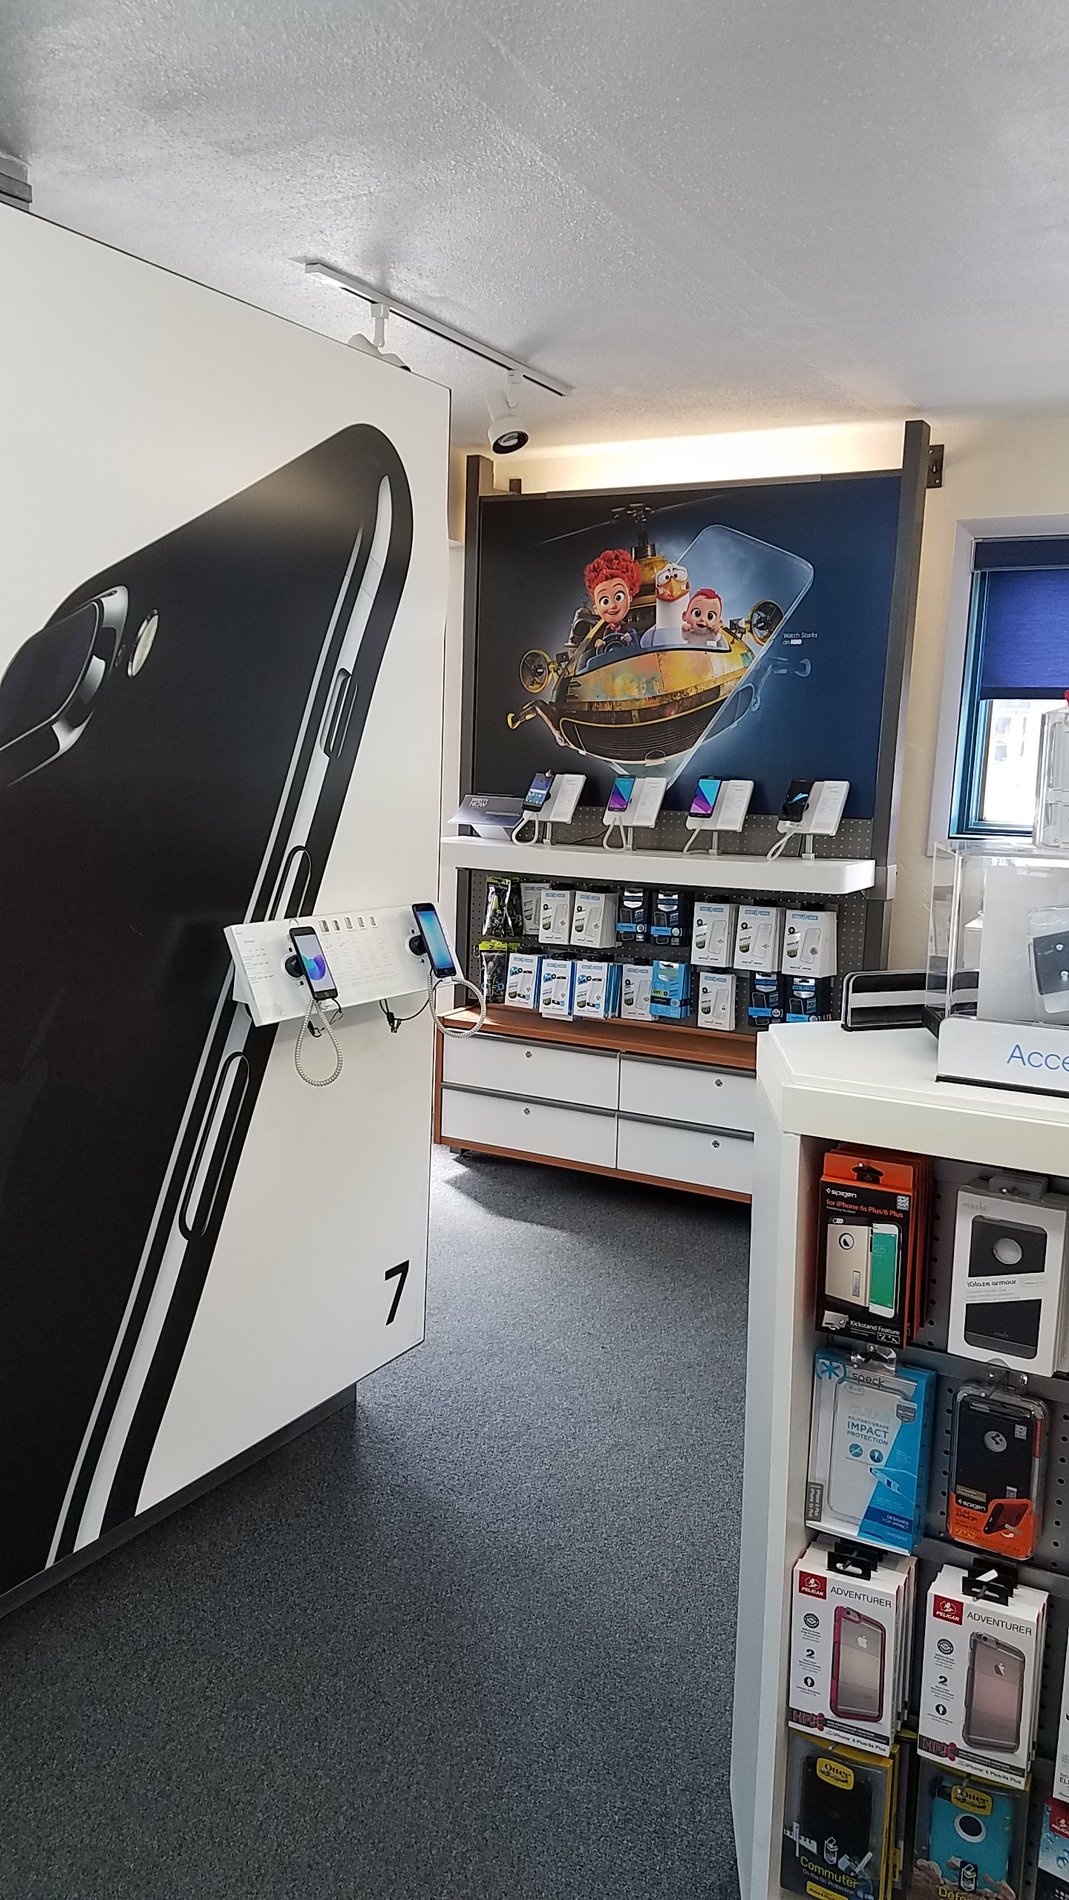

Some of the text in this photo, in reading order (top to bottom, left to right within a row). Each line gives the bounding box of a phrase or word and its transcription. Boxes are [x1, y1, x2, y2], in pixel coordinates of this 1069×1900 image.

[831, 1189, 857, 1199] spigen
[836, 1200, 859, 1211] iPhone
[889, 1210, 904, 1218] Plus
[991, 1279, 1017, 1287] armour
[384, 1259, 409, 1326] 7
[850, 1320, 878, 1331] Kickstand
[878, 1326, 900, 1335] Feature
[852, 1372, 885, 1388] speck
[847, 1420, 889, 1439] IMPACT
[847, 1430, 888, 1446] PROTECTION
[801, 1586, 824, 1596] PELICAN
[830, 1586, 892, 1608] ADVENTURER
[935, 1611, 960, 1622] PELICAN
[966, 1611, 1032, 1636] ADVENTURER
[800, 1855, 858, 1889] Commuter
